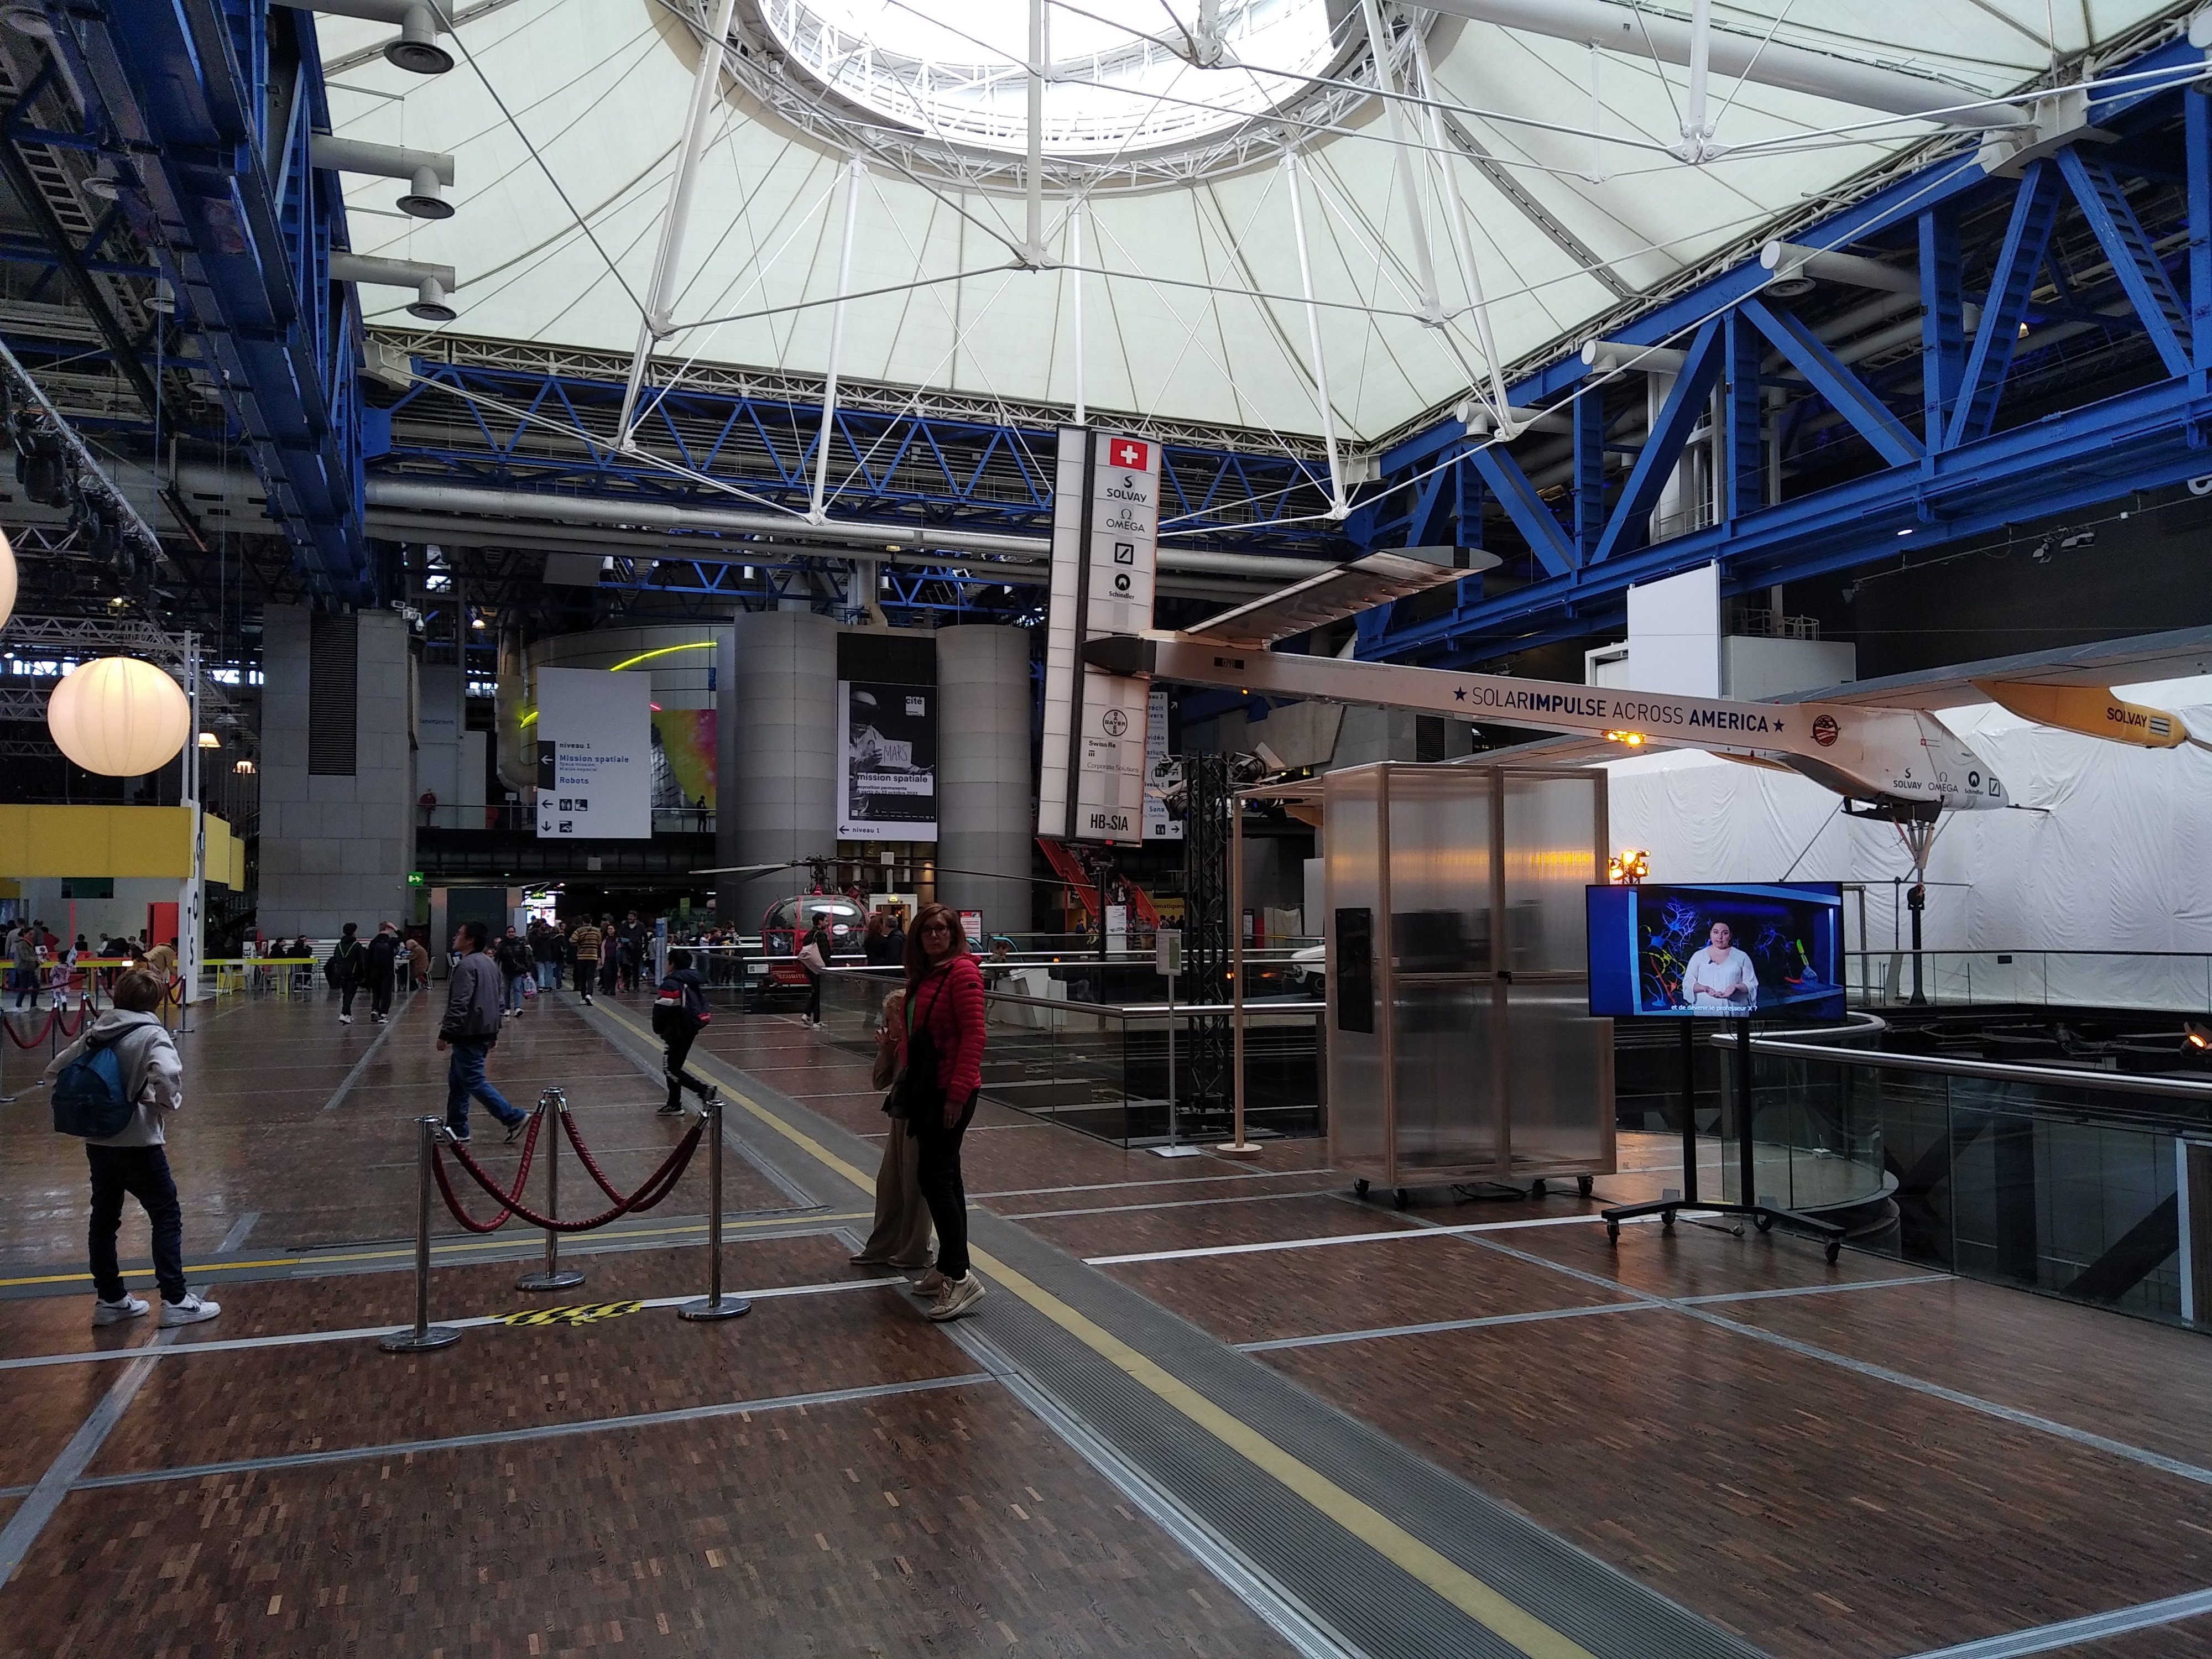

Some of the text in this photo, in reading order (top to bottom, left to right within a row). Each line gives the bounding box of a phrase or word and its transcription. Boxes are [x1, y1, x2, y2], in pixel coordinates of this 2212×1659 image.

[1107, 488, 1147, 503] SOLVAY
[1106, 518, 1145, 533] OMEGA
[1108, 591, 1135, 599] Schindler
[905, 696, 922, 705] cité
[1472, 687, 1768, 733] SOLARIMPULSE ACROSS AMERICA
[2106, 707, 2147, 728] SOLVAY
[594, 755, 629, 764] spatiale
[884, 745, 907, 762] MARS
[1087, 762, 1139, 773] Corporate Solutions
[857, 773, 928, 783] mission spatiale
[1893, 780, 1922, 790] SOLVAY
[1928, 782, 1959, 794] OMEGA
[1091, 813, 1128, 831] HB-SIA
